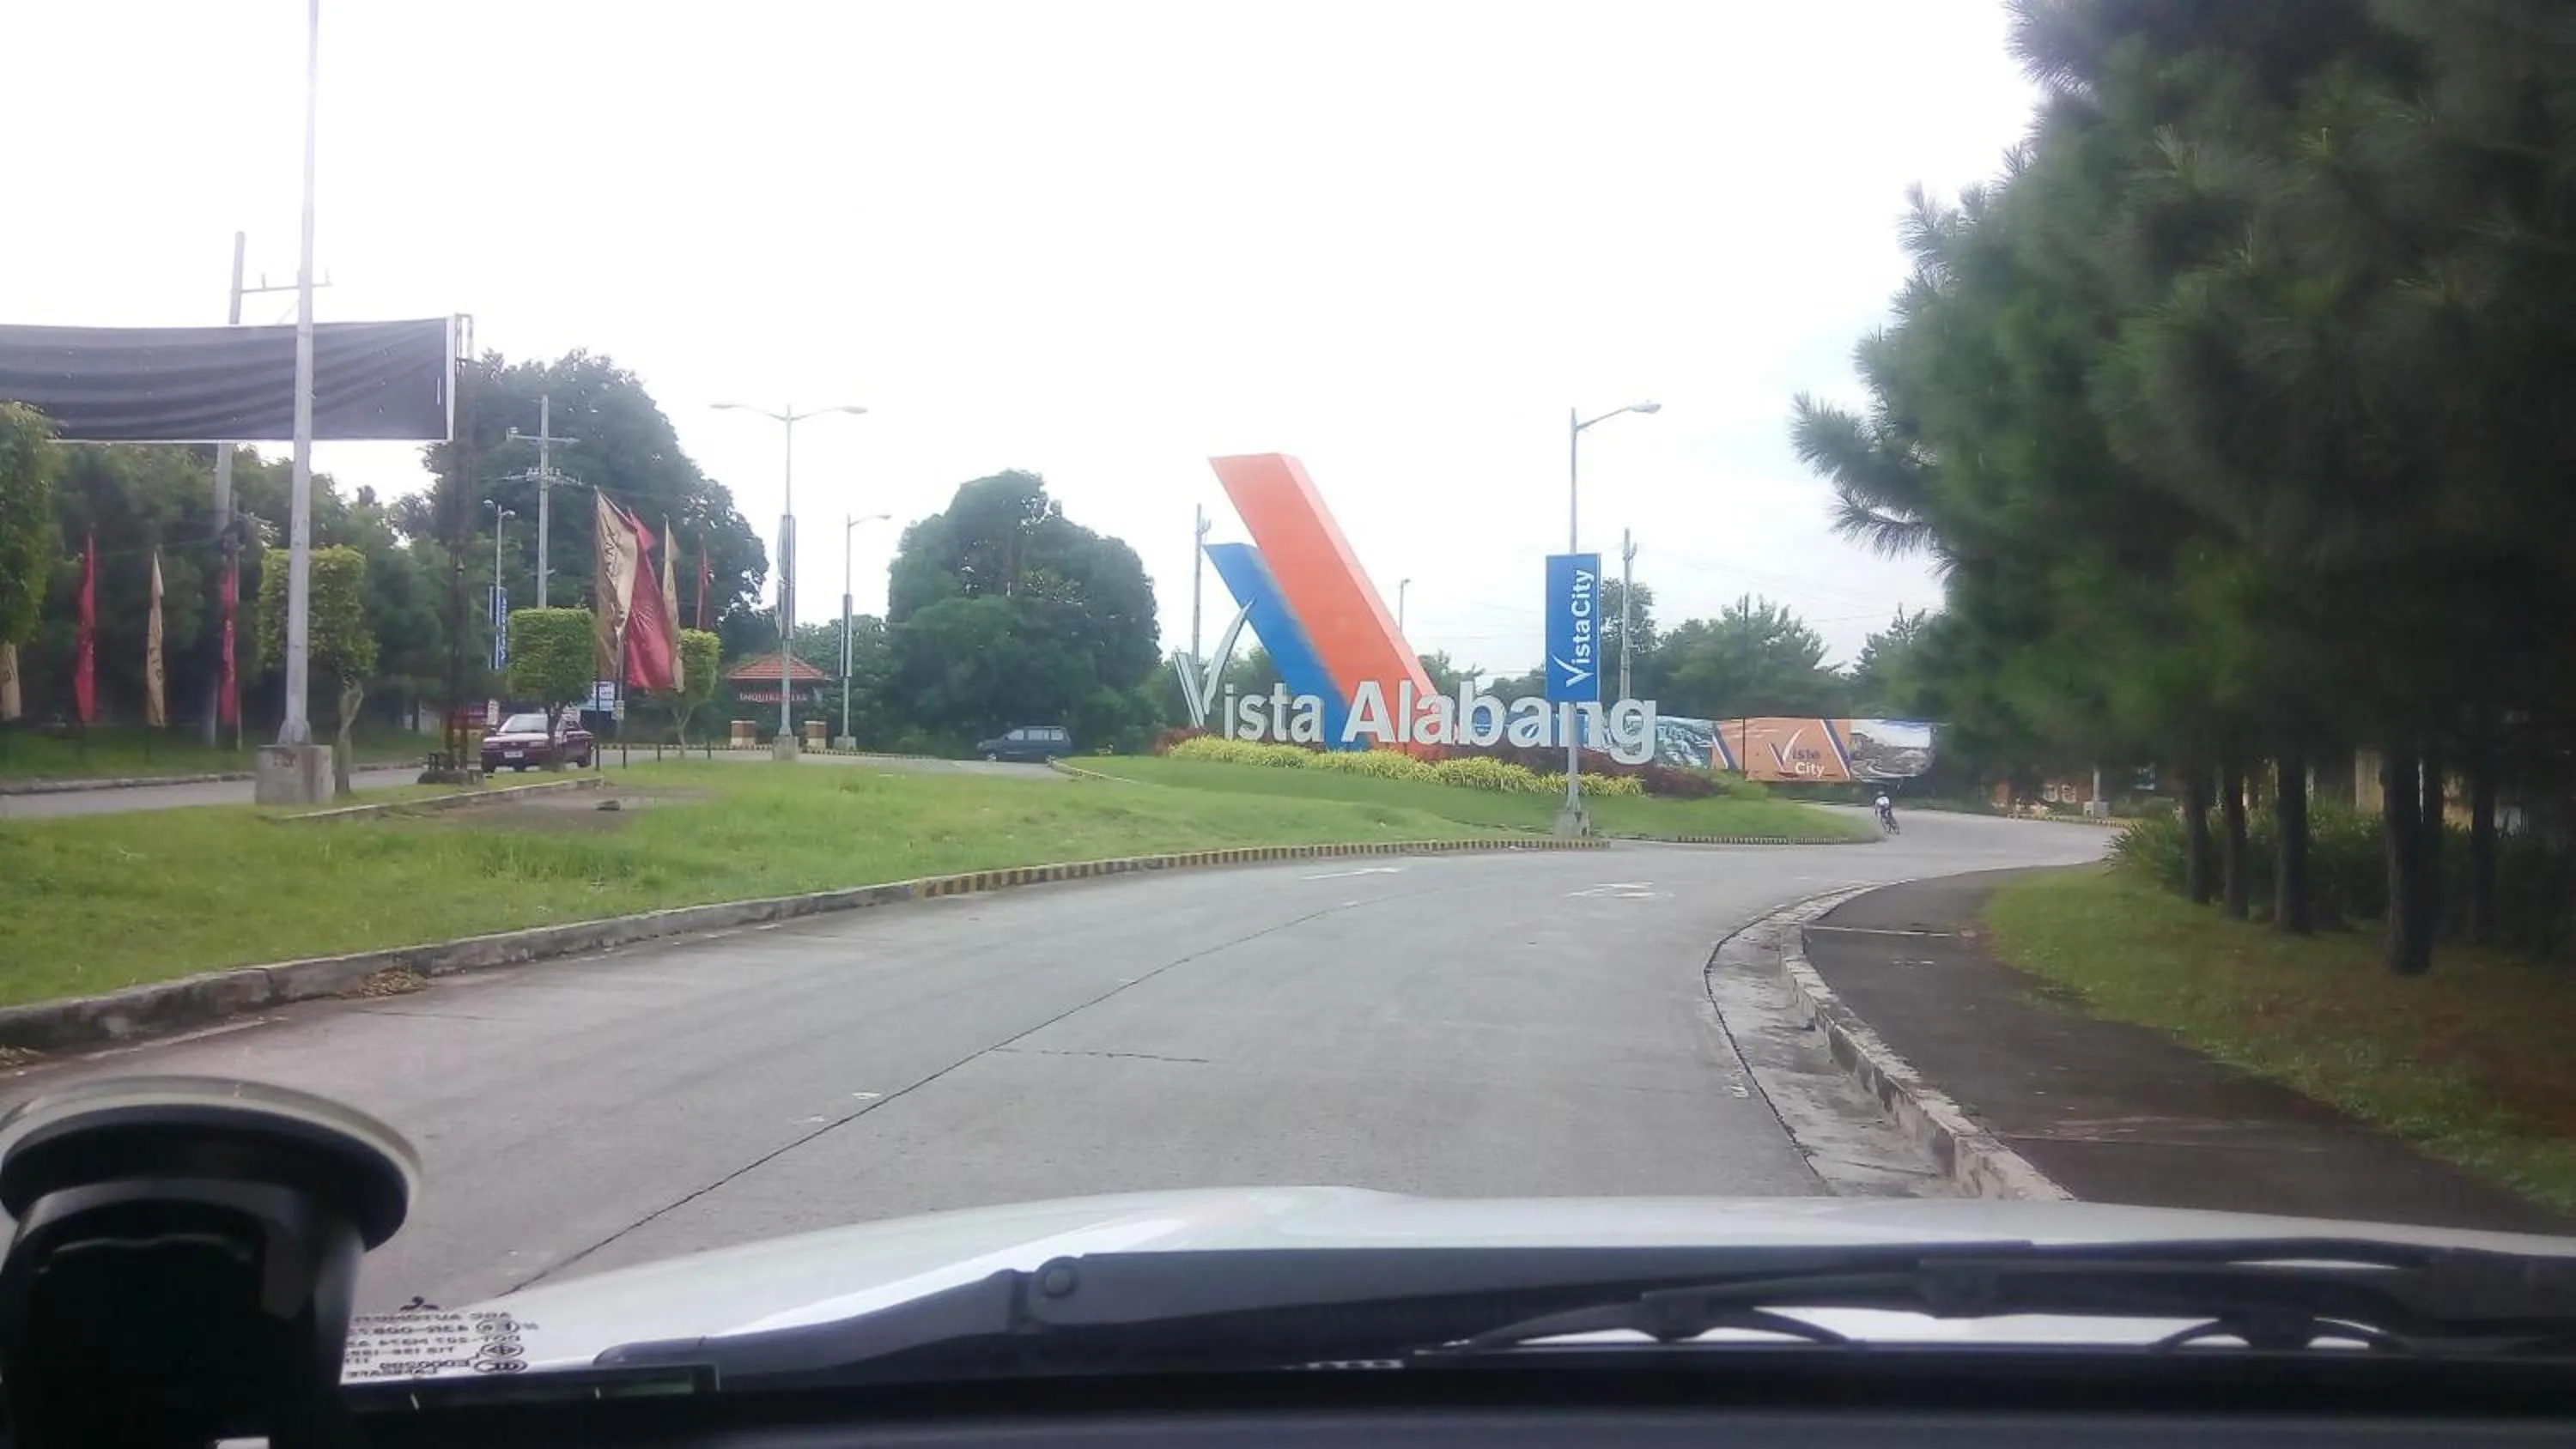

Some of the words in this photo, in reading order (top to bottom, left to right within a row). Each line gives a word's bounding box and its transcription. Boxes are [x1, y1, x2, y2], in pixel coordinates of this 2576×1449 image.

[1174, 597, 1324, 743] Vista
[1340, 680, 1656, 765] Alabang
[1795, 761, 1826, 779] City
